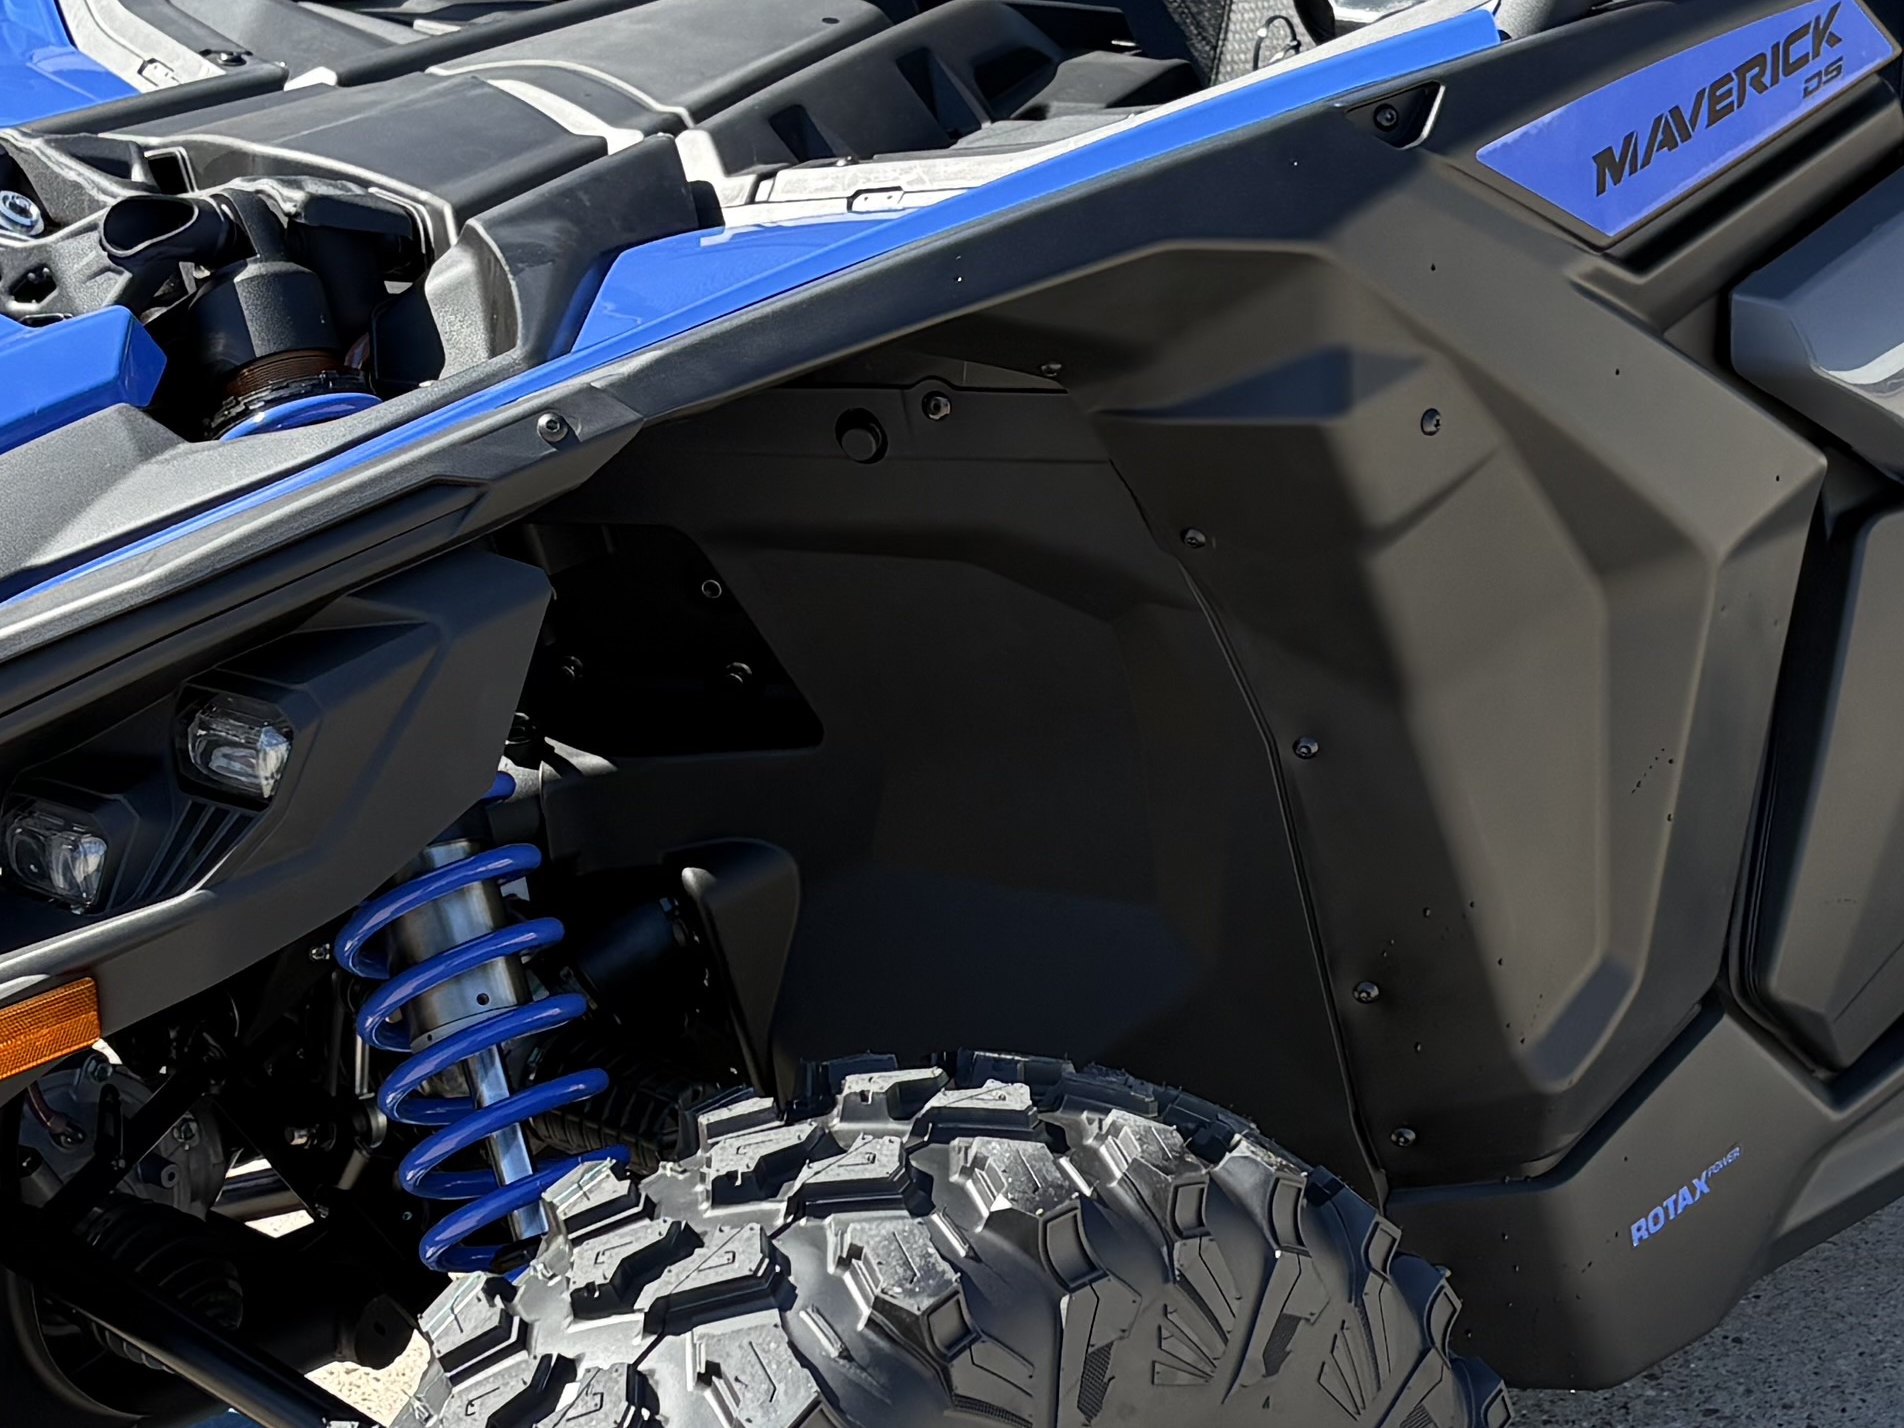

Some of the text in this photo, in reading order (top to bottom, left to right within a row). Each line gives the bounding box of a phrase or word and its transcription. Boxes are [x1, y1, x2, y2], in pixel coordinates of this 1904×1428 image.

[1591, 1, 1843, 197] MAVERICK
[1801, 55, 1845, 100] DS
[1629, 1170, 1711, 1248] ROTAX
